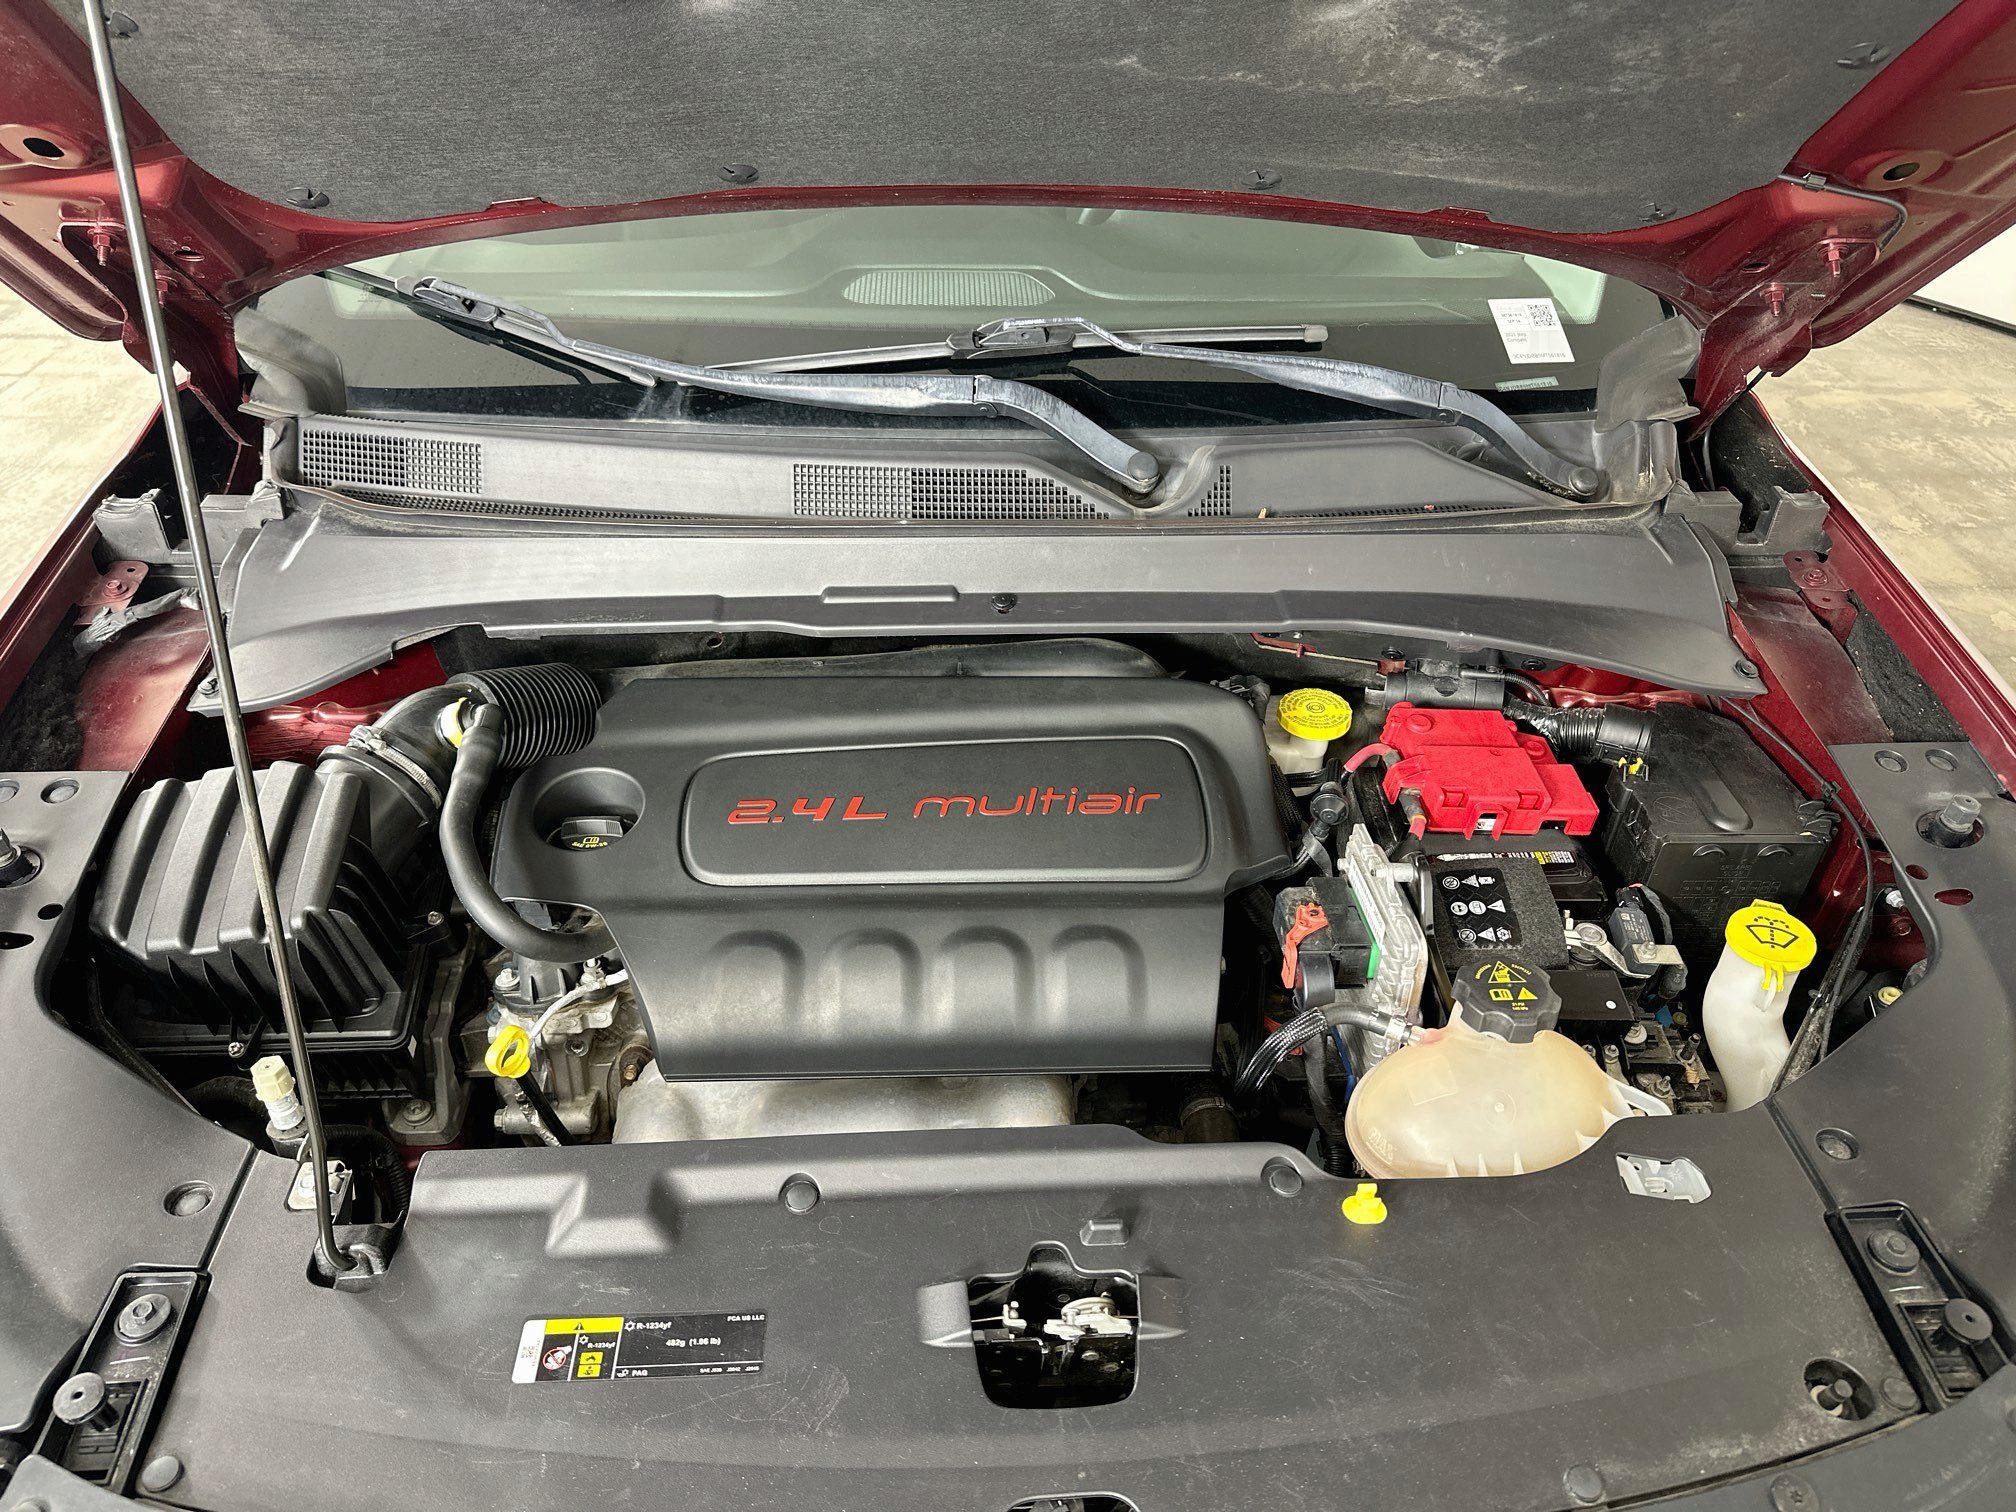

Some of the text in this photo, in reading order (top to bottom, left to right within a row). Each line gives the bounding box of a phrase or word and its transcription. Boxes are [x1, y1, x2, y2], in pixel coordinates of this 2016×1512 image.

[913, 786, 1162, 818] multiair
[636, 1322, 672, 1330] R-1234yf
[587, 1341, 616, 1350] R-1234yf
[665, 1339, 686, 1348] 482g
[631, 1369, 648, 1377] PAG
